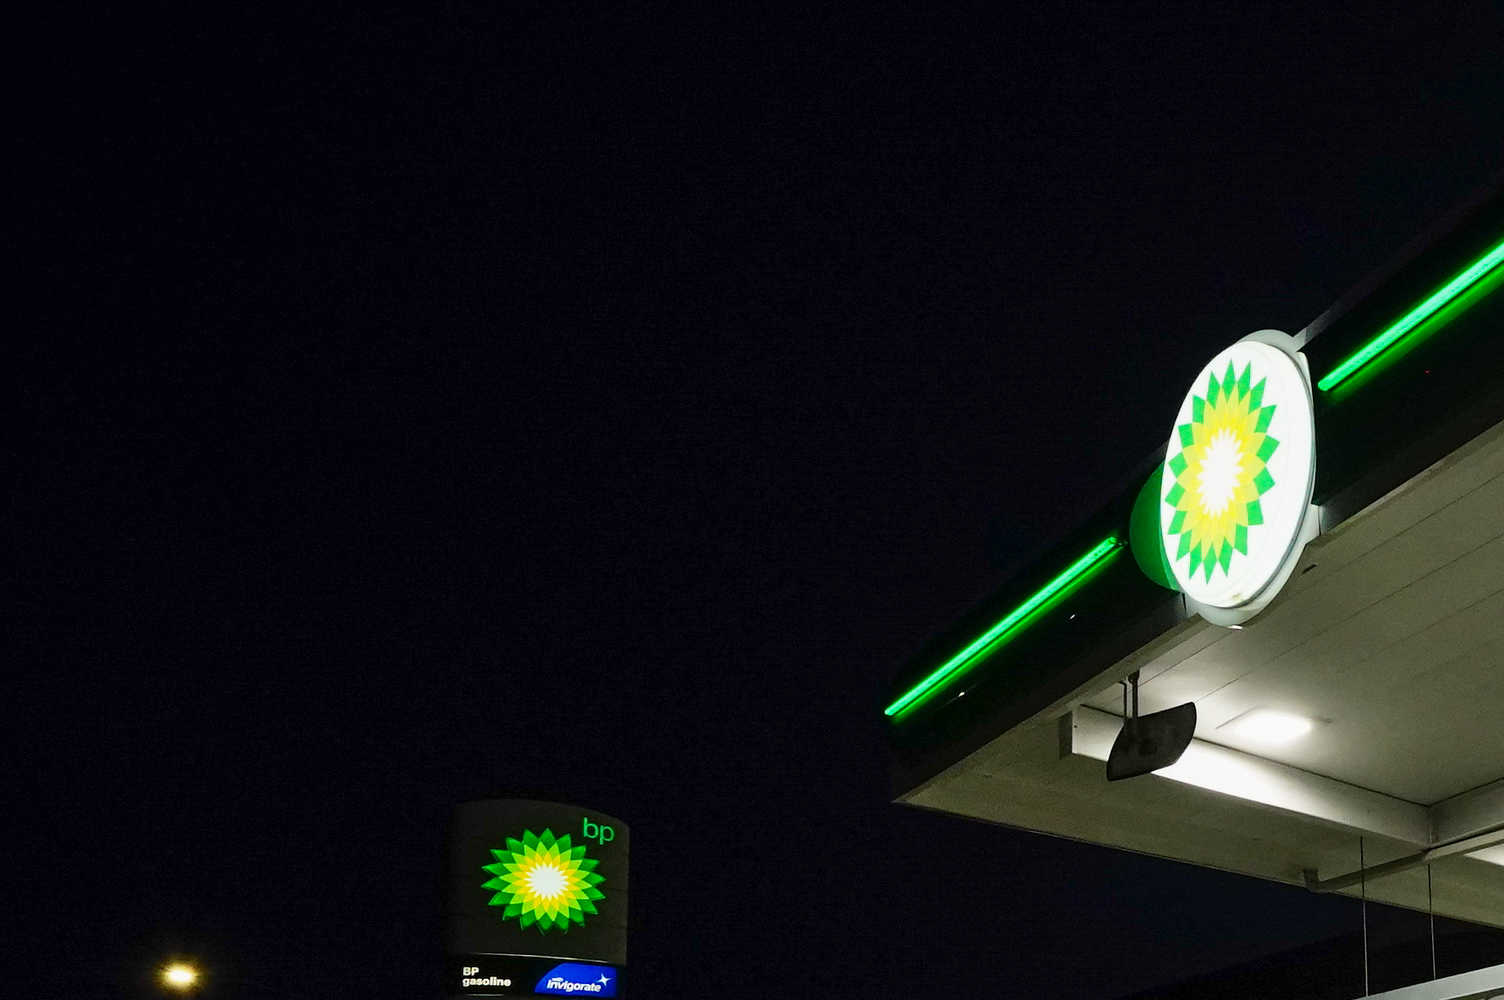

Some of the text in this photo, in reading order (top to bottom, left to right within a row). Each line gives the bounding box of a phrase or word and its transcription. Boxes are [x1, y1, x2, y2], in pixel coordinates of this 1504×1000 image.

[583, 817, 615, 845] bp
[462, 967, 480, 976] BP
[462, 977, 512, 988] gasoline
[547, 978, 602, 993] Invigorate
